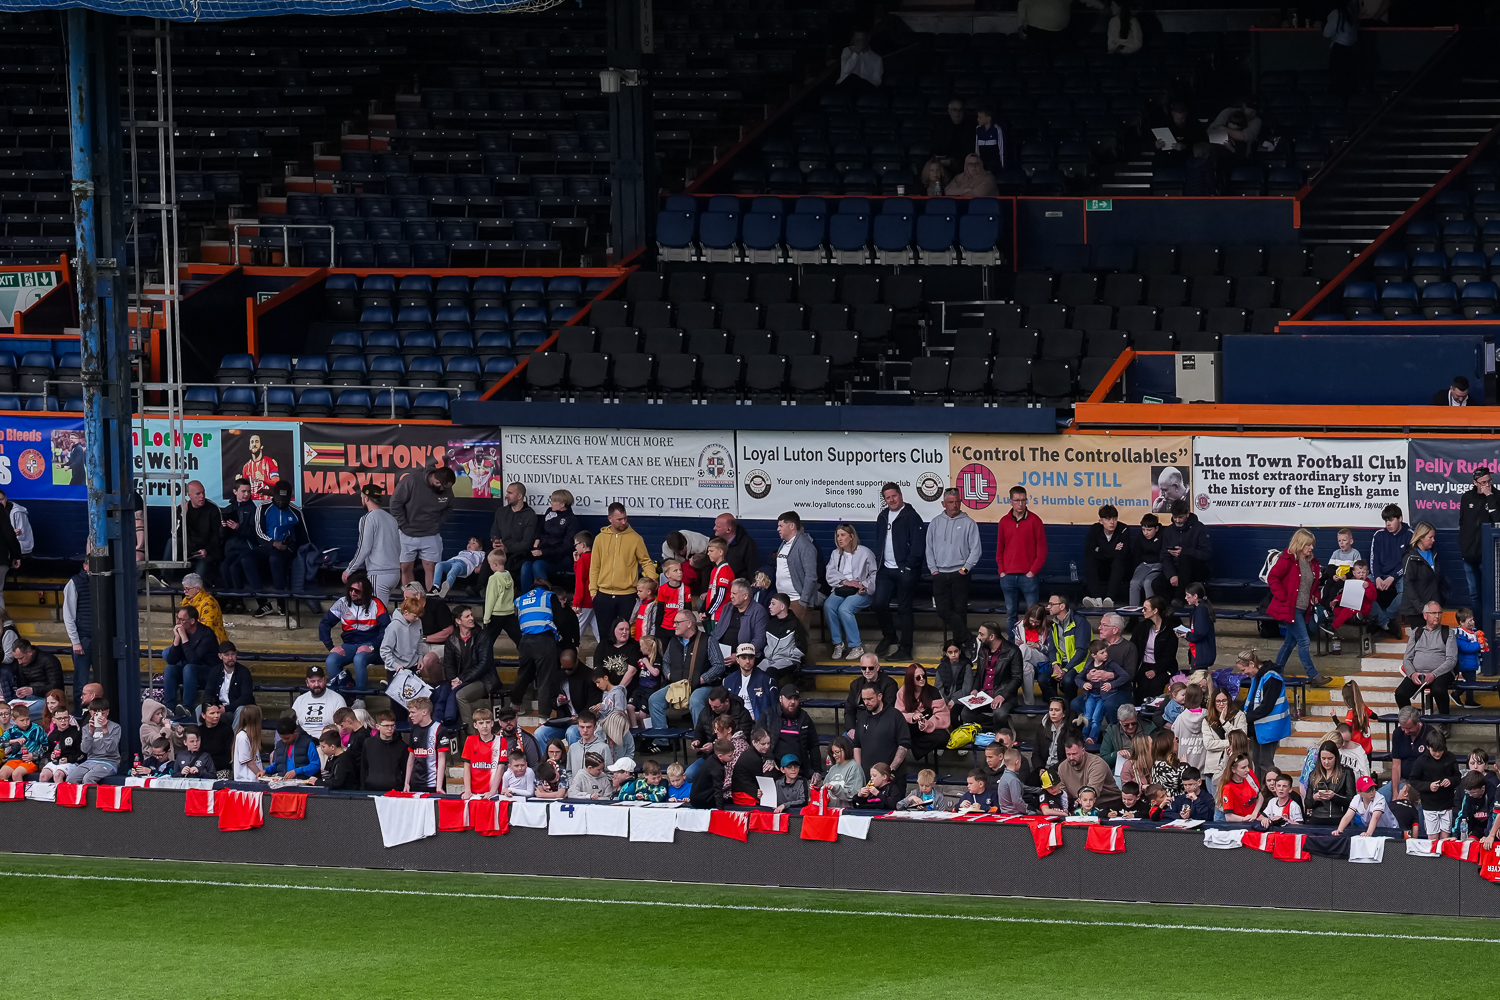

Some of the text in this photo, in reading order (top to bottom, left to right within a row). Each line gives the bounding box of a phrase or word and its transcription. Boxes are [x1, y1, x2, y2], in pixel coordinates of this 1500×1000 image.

[6, 428, 42, 442] Bleeds
[530, 434, 580, 445] AMAZING
[584, 435, 608, 446] HOW
[610, 436, 640, 446] MUCH
[643, 436, 674, 447] MORE
[147, 452, 198, 470] Welsh
[346, 444, 445, 468] LUTON'S
[505, 454, 695, 467] SUCCESSFUL A TEAM CAN BE WHEN
[744, 446, 779, 464] Loyal
[784, 447, 823, 462] Luton
[828, 447, 906, 465] Supporters
[910, 448, 944, 463] Club
[1028, 448, 1060, 462] The
[1194, 453, 1406, 470] Luton Town Football Club
[1416, 458, 1453, 476] Pelly
[303, 470, 410, 496] MARVEL
[506, 473, 521, 484] NO
[524, 473, 584, 485] INDIVIDUAL
[586, 474, 624, 485] TAKES
[626, 475, 648, 486] THE
[794, 478, 809, 486] only
[1018, 471, 1122, 487] JOHN STILL
[1202, 470, 1401, 484] The most extraordinary story in
[134, 479, 188, 496] arrio
[1208, 484, 1399, 499] the history of the English game
[1416, 481, 1444, 494] Every
[647, 498, 665, 508] TO
[669, 498, 692, 509] THE
[696, 498, 729, 510] CORE
[794, 501, 876, 509] www.loyallutonsc.co.uk
[1042, 496, 1084, 506] Humble
[1086, 496, 1149, 507] Gentleman
[1180, 737, 1204, 746] WHIT
[1187, 746, 1204, 755] FOX
